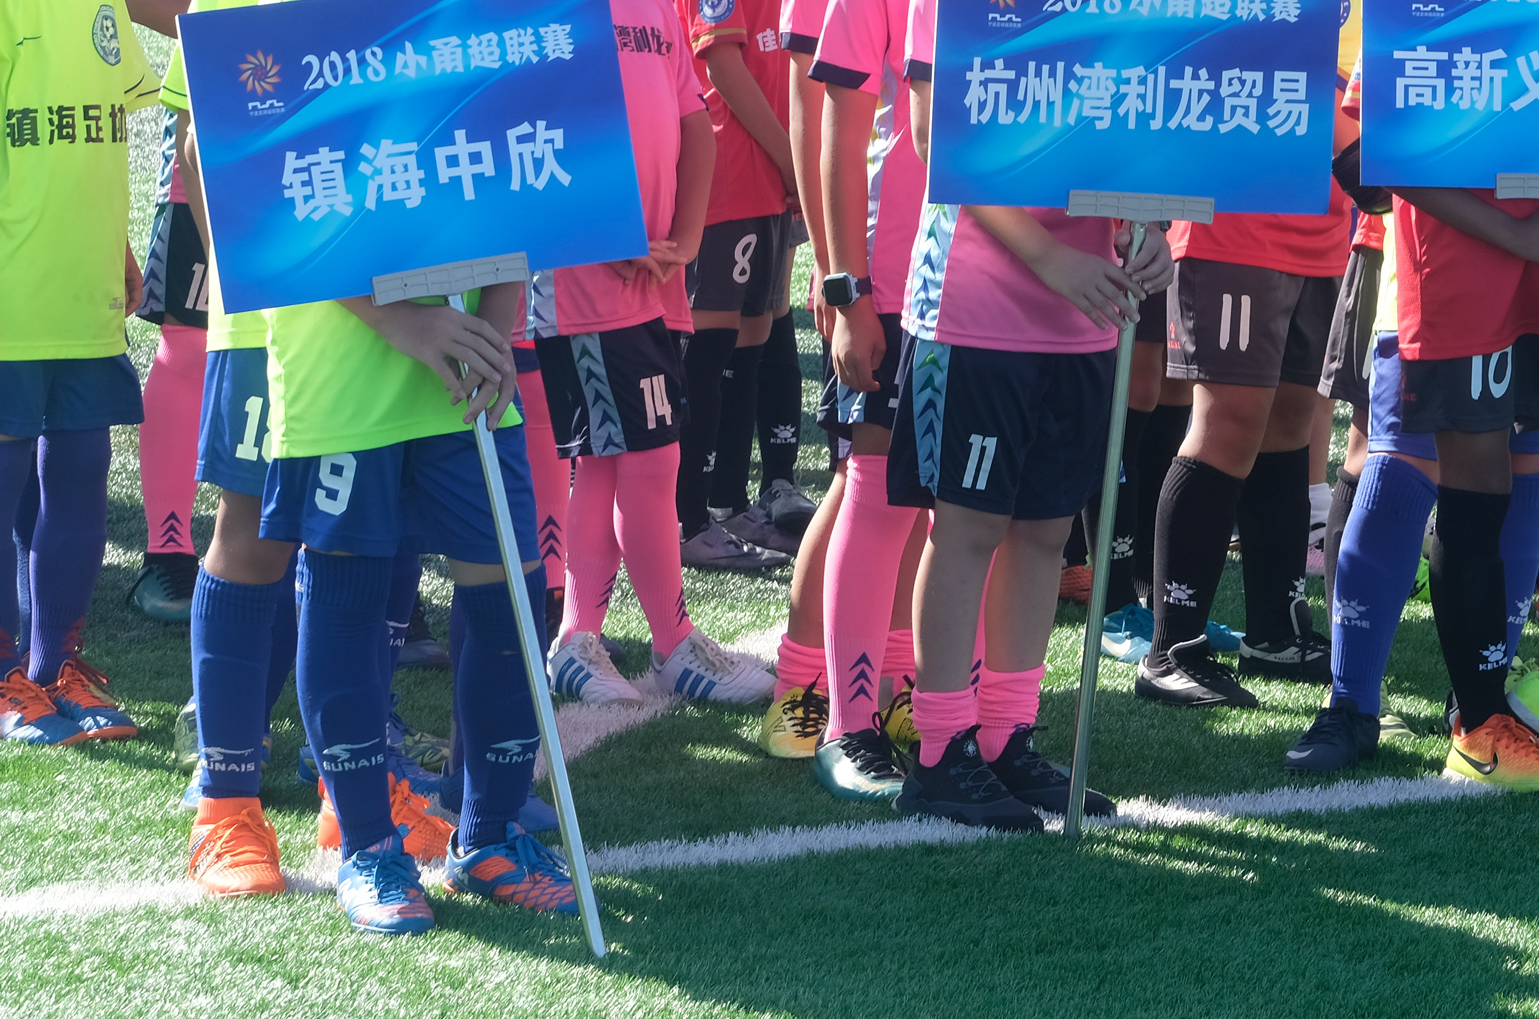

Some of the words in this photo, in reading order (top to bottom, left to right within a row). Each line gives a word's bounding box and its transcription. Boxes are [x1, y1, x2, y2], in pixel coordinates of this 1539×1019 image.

[963, 57, 1310, 137] 杭州湾利龙贸易
[281, 120, 573, 222] 镇海中欣
[732, 233, 758, 284] 8
[639, 373, 673, 430] 14
[314, 451, 358, 517] 9
[961, 433, 998, 491] 11
[1163, 595, 1198, 608] KELME
[322, 753, 385, 772] SUNAIS
